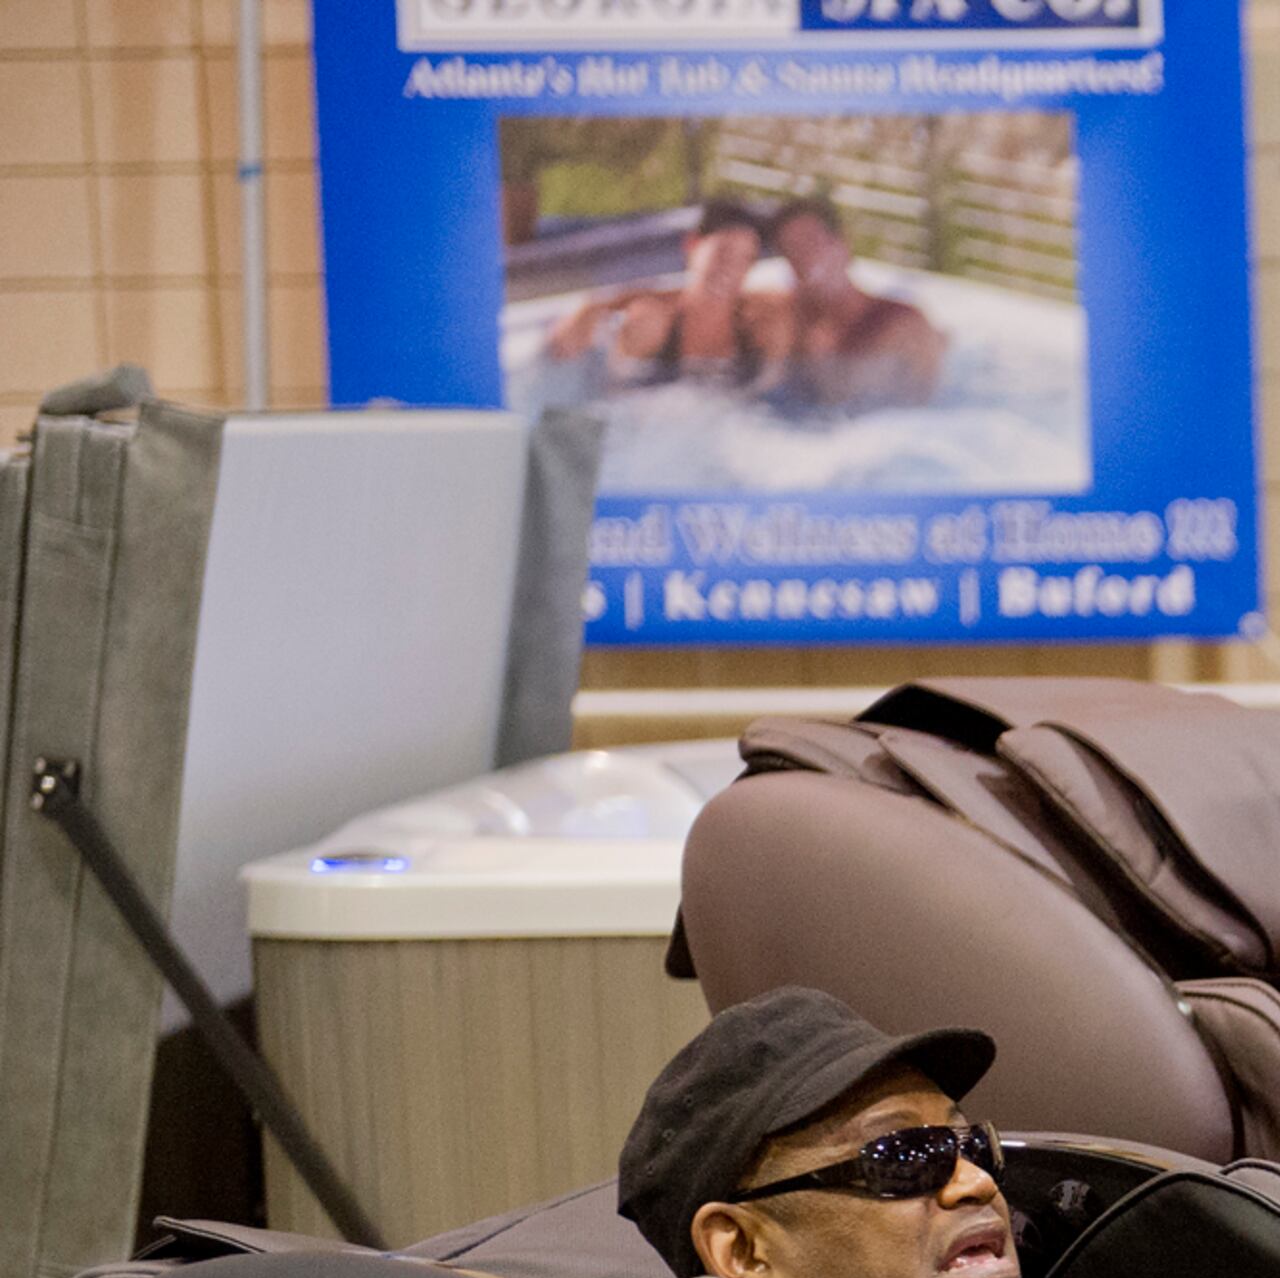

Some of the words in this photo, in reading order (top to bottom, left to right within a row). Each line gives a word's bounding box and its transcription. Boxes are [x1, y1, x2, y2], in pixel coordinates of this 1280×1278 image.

[403, 56, 574, 98] Atlanta's
[576, 55, 649, 96] Hot
[657, 55, 731, 96] Tub
[777, 58, 896, 95] Sauna
[675, 502, 917, 566] Wellness
[924, 503, 986, 565] at
[988, 499, 1164, 563] Home
[663, 567, 939, 622] Kennesaw
[998, 563, 1196, 618] Buford
